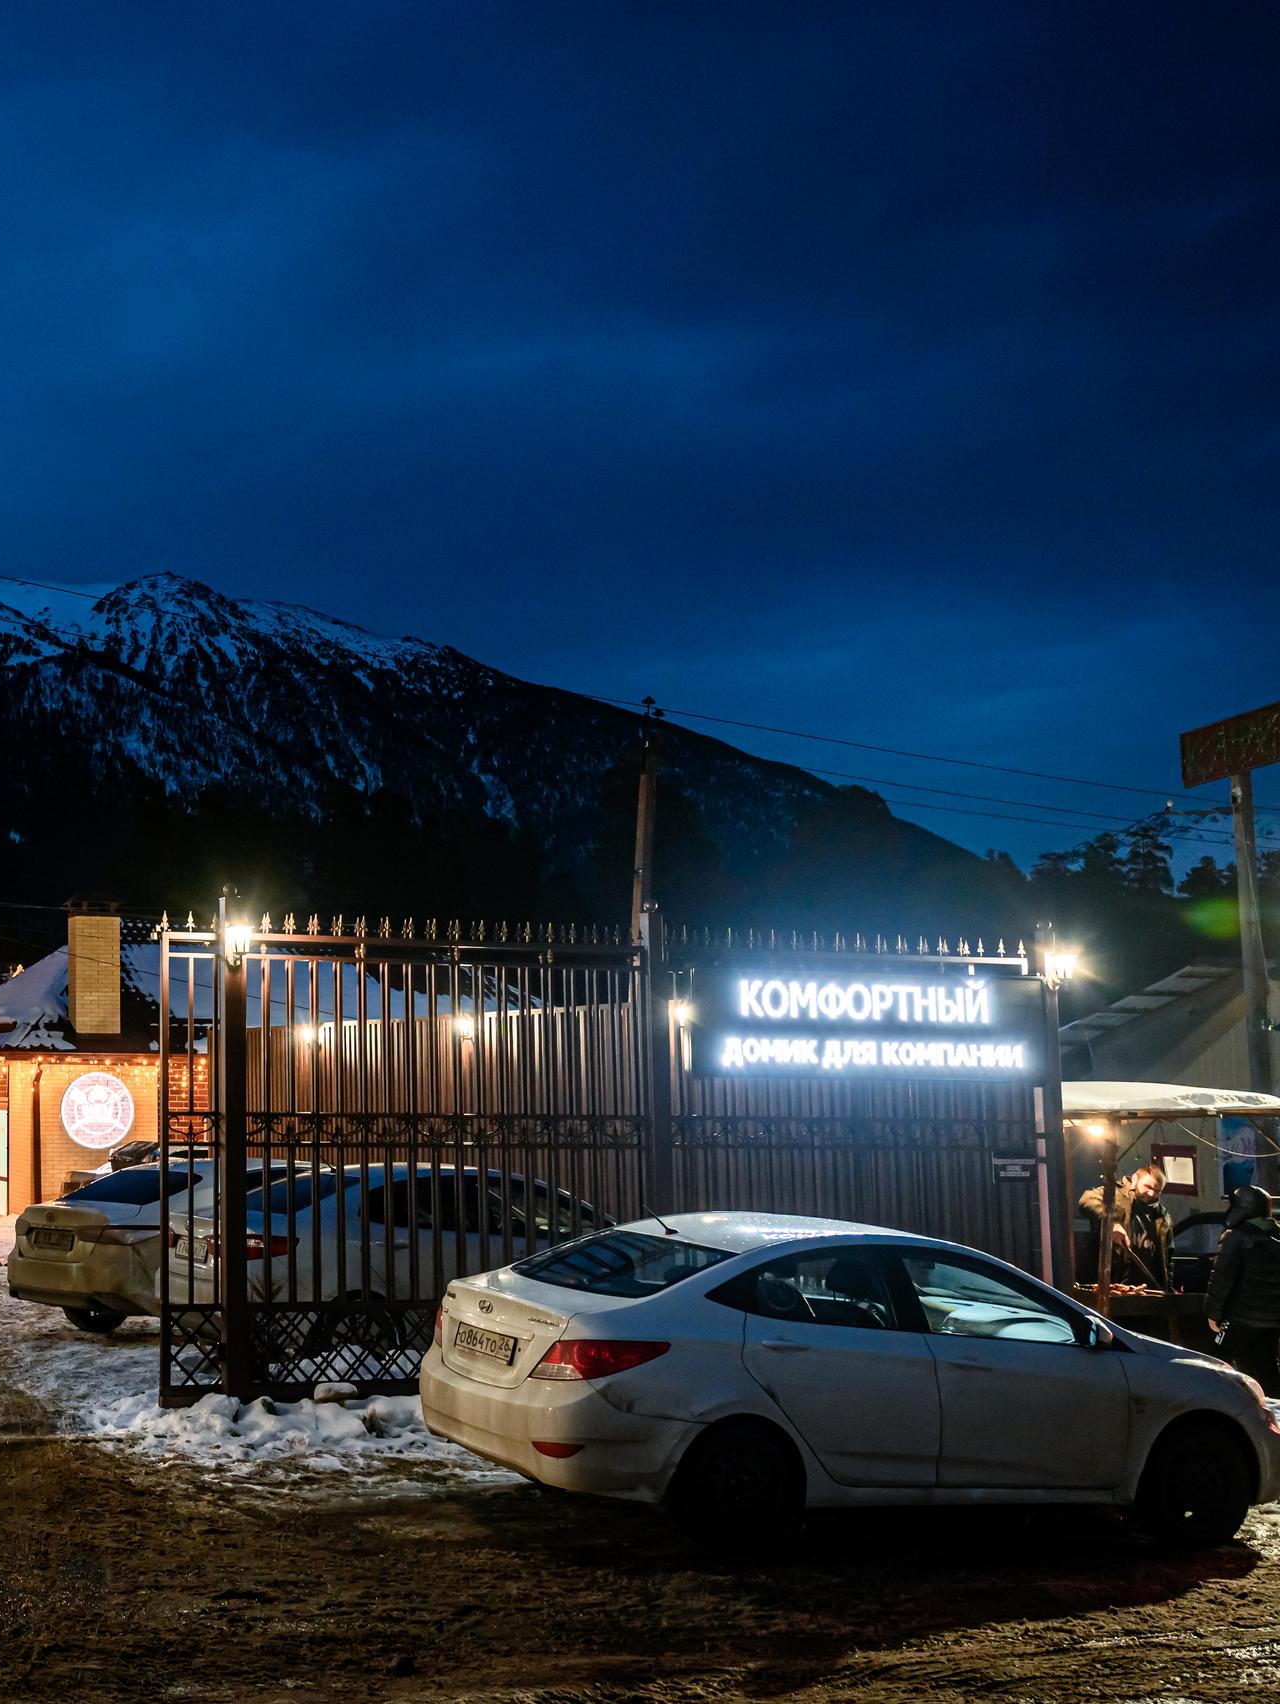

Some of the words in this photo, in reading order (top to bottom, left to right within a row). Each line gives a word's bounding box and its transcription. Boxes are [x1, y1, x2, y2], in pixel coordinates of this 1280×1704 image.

[739, 979, 989, 1023] КОМФОРТНЫЙ
[722, 1037, 818, 1068] ДОМИК
[822, 1040, 877, 1069] ДЛЯ
[881, 1042, 1023, 1068] КОМПАНИИ
